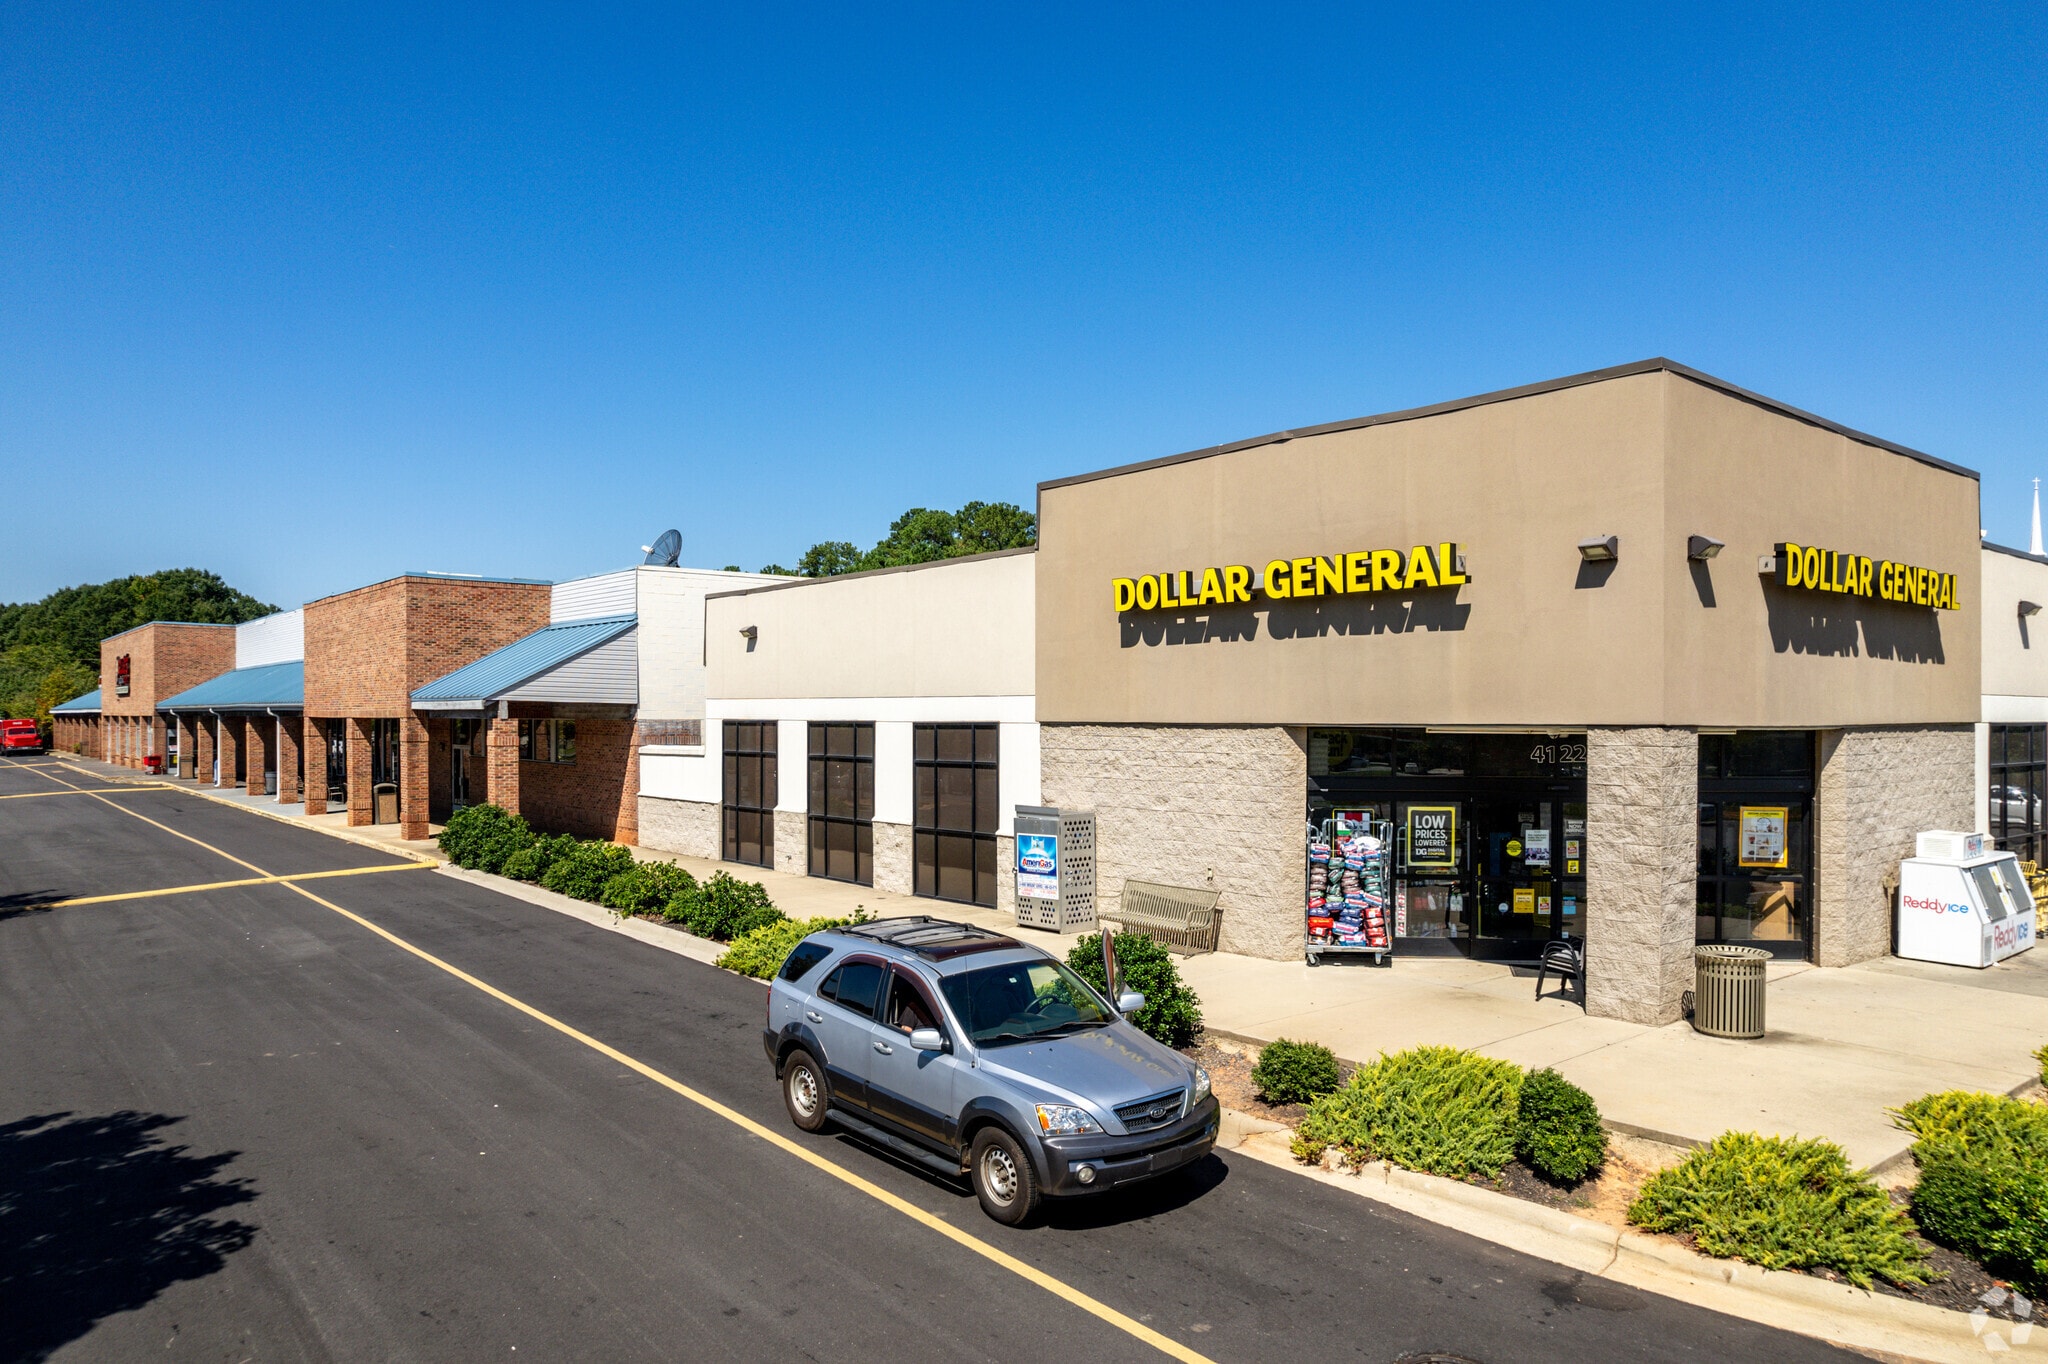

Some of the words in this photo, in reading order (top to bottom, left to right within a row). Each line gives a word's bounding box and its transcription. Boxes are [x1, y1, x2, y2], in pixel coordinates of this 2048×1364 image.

[1112, 565, 1252, 612] DOLLAR
[1263, 542, 1466, 600] GENERAL
[1785, 542, 1873, 597] DOLLAR
[1879, 560, 1960, 610] GENERAL
[1530, 744, 1587, 764] 4122
[1415, 815, 1446, 829] LOW
[1415, 829, 1448, 840] PRICES,
[1415, 839, 1448, 847] LOWERED.
[1415, 848, 1427, 856] DG
[1022, 858, 1053, 869] AmeriGas
[1903, 895, 1947, 914] Reddy
[1994, 920, 2017, 951] Reddy
[1153, 1108, 1164, 1117] KIA
